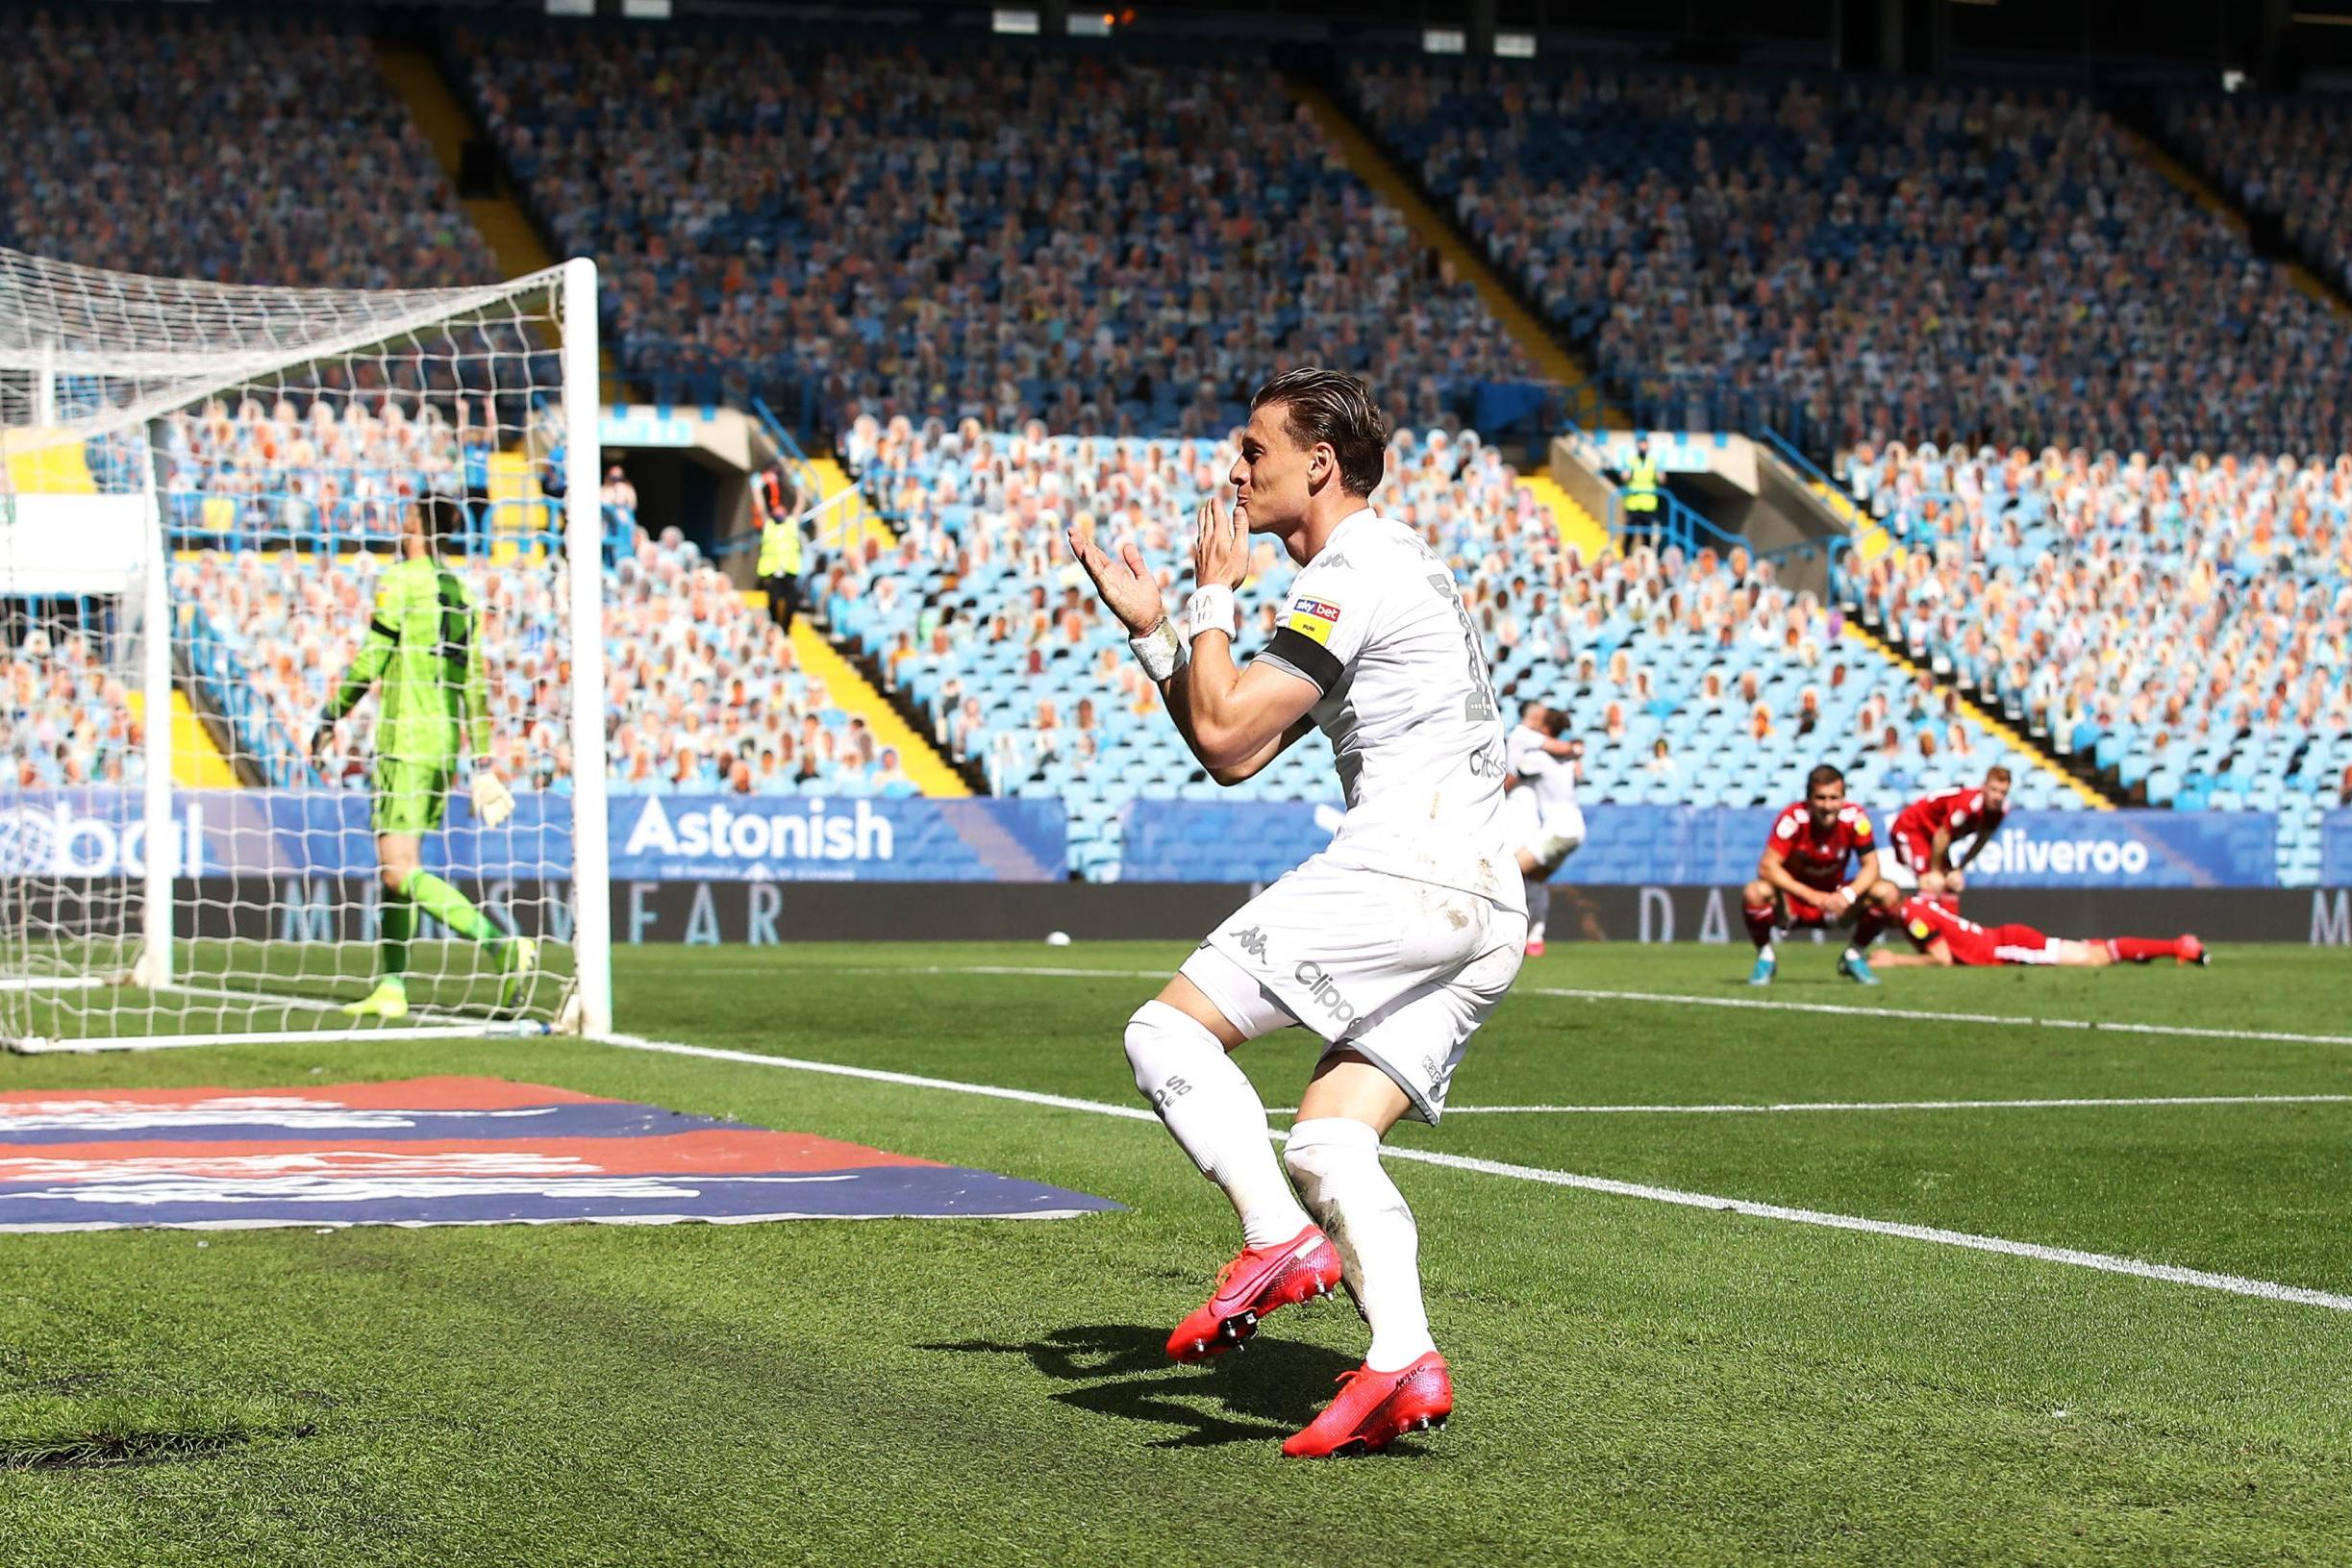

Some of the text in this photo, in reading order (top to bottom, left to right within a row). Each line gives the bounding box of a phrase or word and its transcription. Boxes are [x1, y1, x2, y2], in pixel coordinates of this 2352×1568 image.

[1295, 599, 1339, 620] sky bet
[624, 793, 893, 860] Astonish
